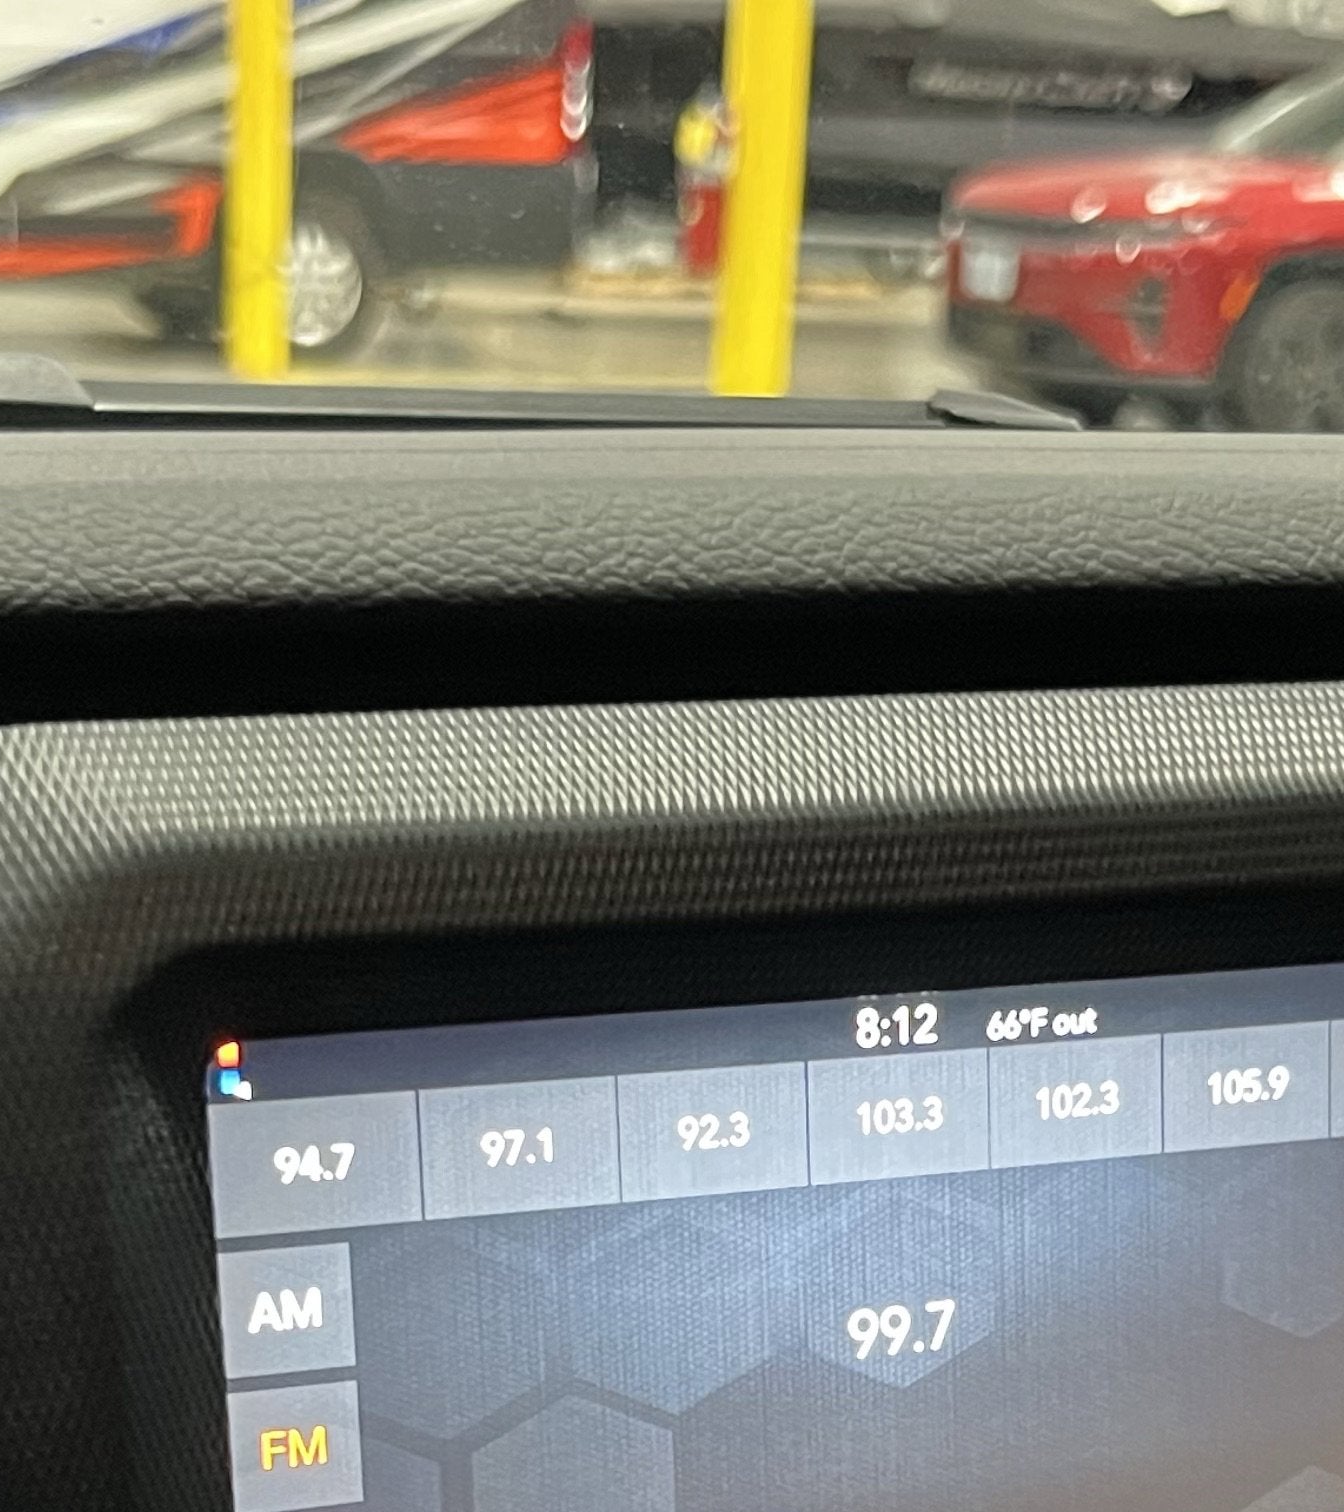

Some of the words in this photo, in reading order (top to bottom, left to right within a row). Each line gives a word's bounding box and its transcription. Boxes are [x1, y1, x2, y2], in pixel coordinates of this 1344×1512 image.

[856, 1002, 939, 1049] 8:12
[986, 1006, 1049, 1041] 66°F
[1052, 1006, 1097, 1036] out
[1035, 1078, 1121, 1121] 102.3
[1207, 1065, 1291, 1106] 105.9
[676, 1107, 752, 1152] 92.3
[855, 1095, 944, 1136] 103.3
[273, 1142, 355, 1185] 94.7
[479, 1126, 554, 1168] 97.1
[247, 1286, 323, 1335] AM
[846, 1298, 956, 1360] 99.7
[260, 1427, 328, 1469] FM
